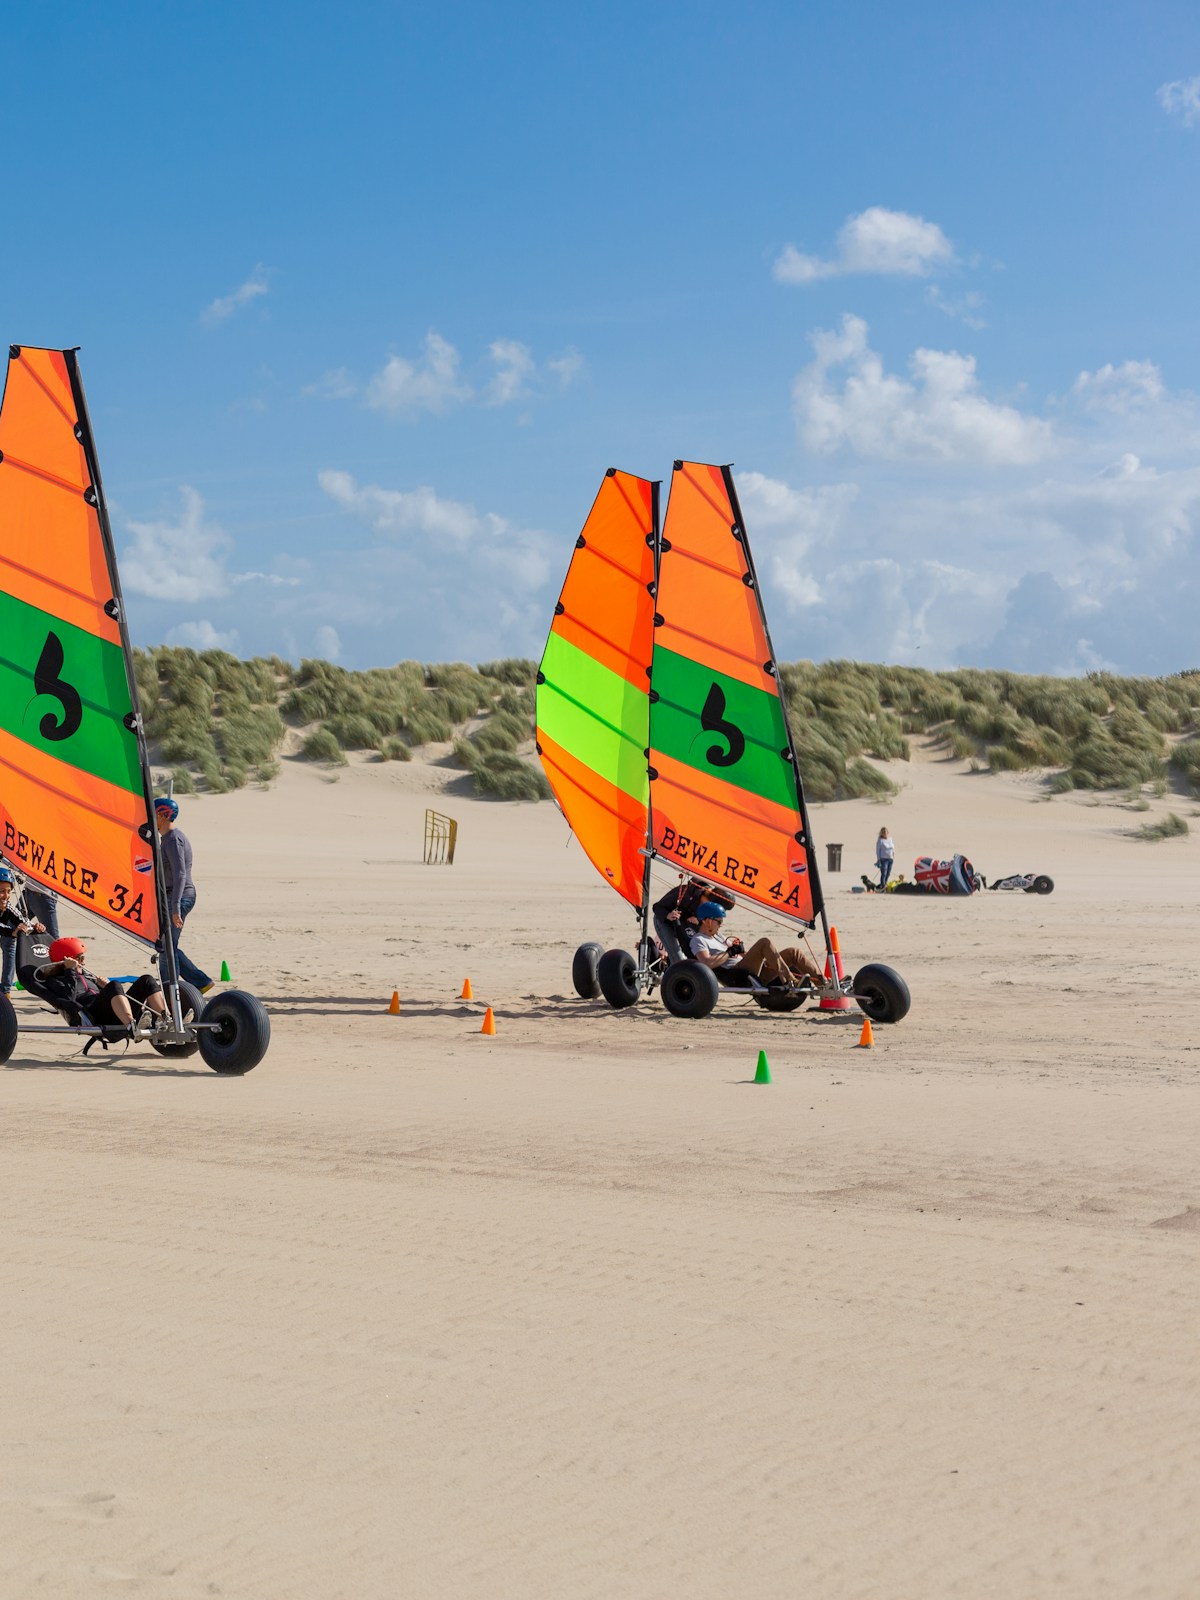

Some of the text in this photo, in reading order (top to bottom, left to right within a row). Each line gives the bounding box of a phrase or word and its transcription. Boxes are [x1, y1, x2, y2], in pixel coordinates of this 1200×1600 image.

[3, 821, 144, 924] BEWARE 3A
[660, 826, 801, 909] BEWARE 4A
